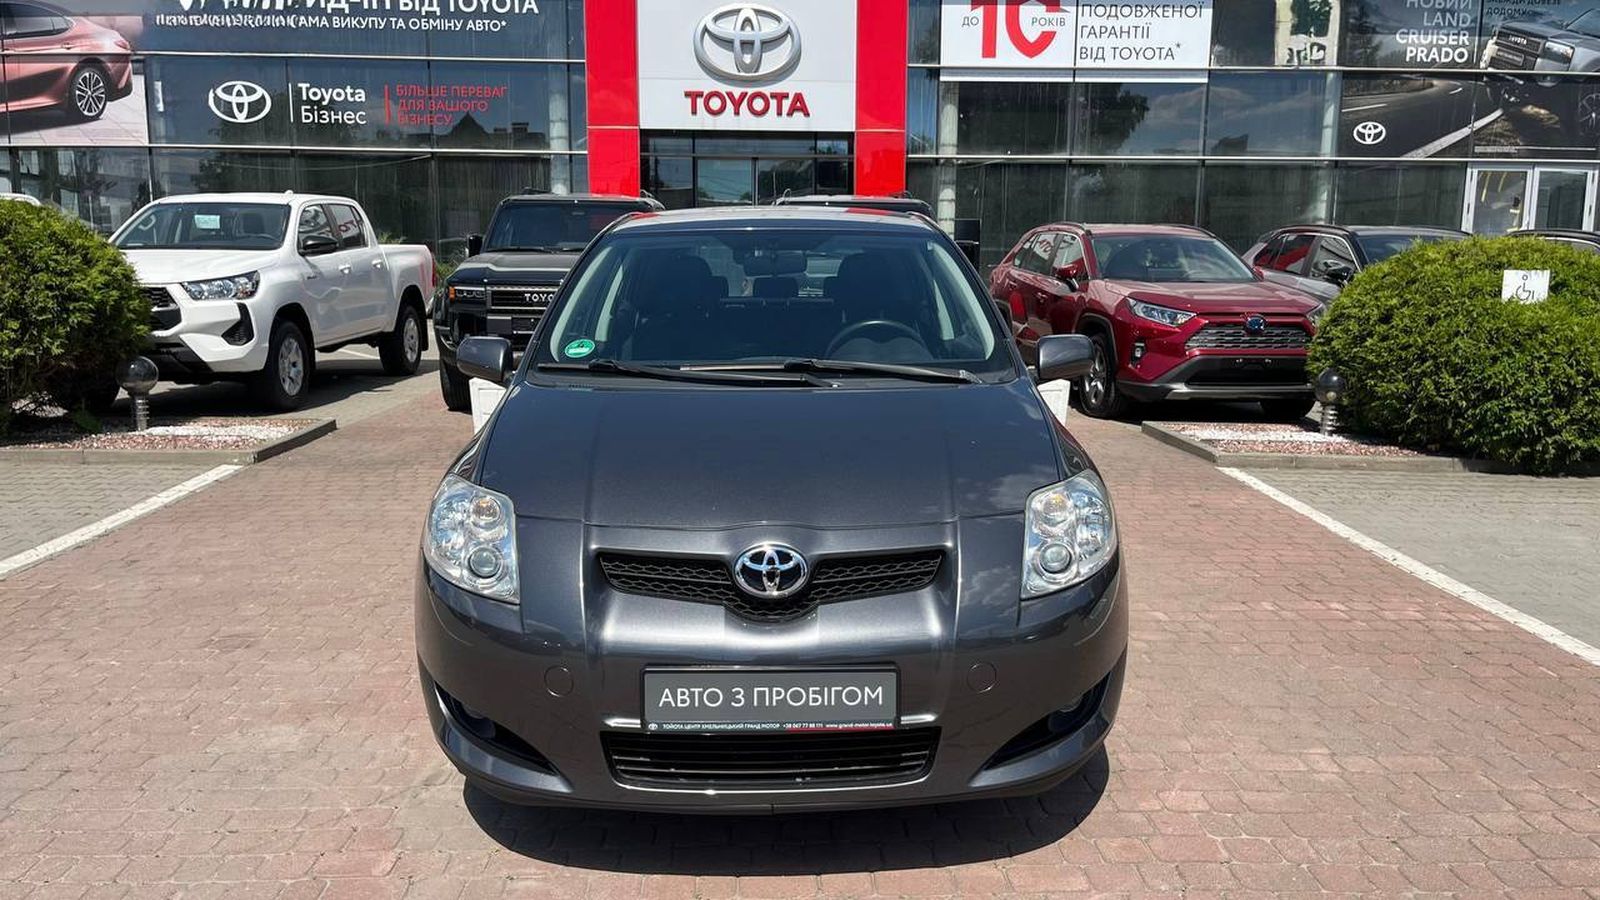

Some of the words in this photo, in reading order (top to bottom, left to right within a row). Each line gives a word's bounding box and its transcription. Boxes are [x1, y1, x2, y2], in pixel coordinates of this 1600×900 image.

[332, 16, 387, 29] ВИКУПУ
[389, 18, 407, 30] ТА
[408, 18, 464, 32] ОБМІНУ
[961, 17, 980, 28] ДО
[1031, 17, 1067, 28] РОКІВ
[1423, 13, 1471, 27] LAND
[1079, 22, 1153, 40] ГАРАНТІЇ
[1395, 29, 1471, 46] CRUISER
[1079, 47, 1106, 62] ВІД
[1405, 48, 1470, 63] PRADO
[297, 82, 367, 106] Toyota
[396, 84, 447, 97] БІЛЬШЕ
[451, 85, 508, 98] ПЕРЕВАГ
[399, 99, 426, 112] ДЛЯ
[429, 100, 489, 112] ВАШОГО
[684, 90, 811, 118] TOYOTA
[301, 105, 367, 125] Бізнес
[397, 112, 453, 126] БІЗНЕСУ
[524, 293, 555, 302] TOYO
[658, 687, 724, 708] АВТО
[753, 686, 883, 707] ПРОБІГОМ
